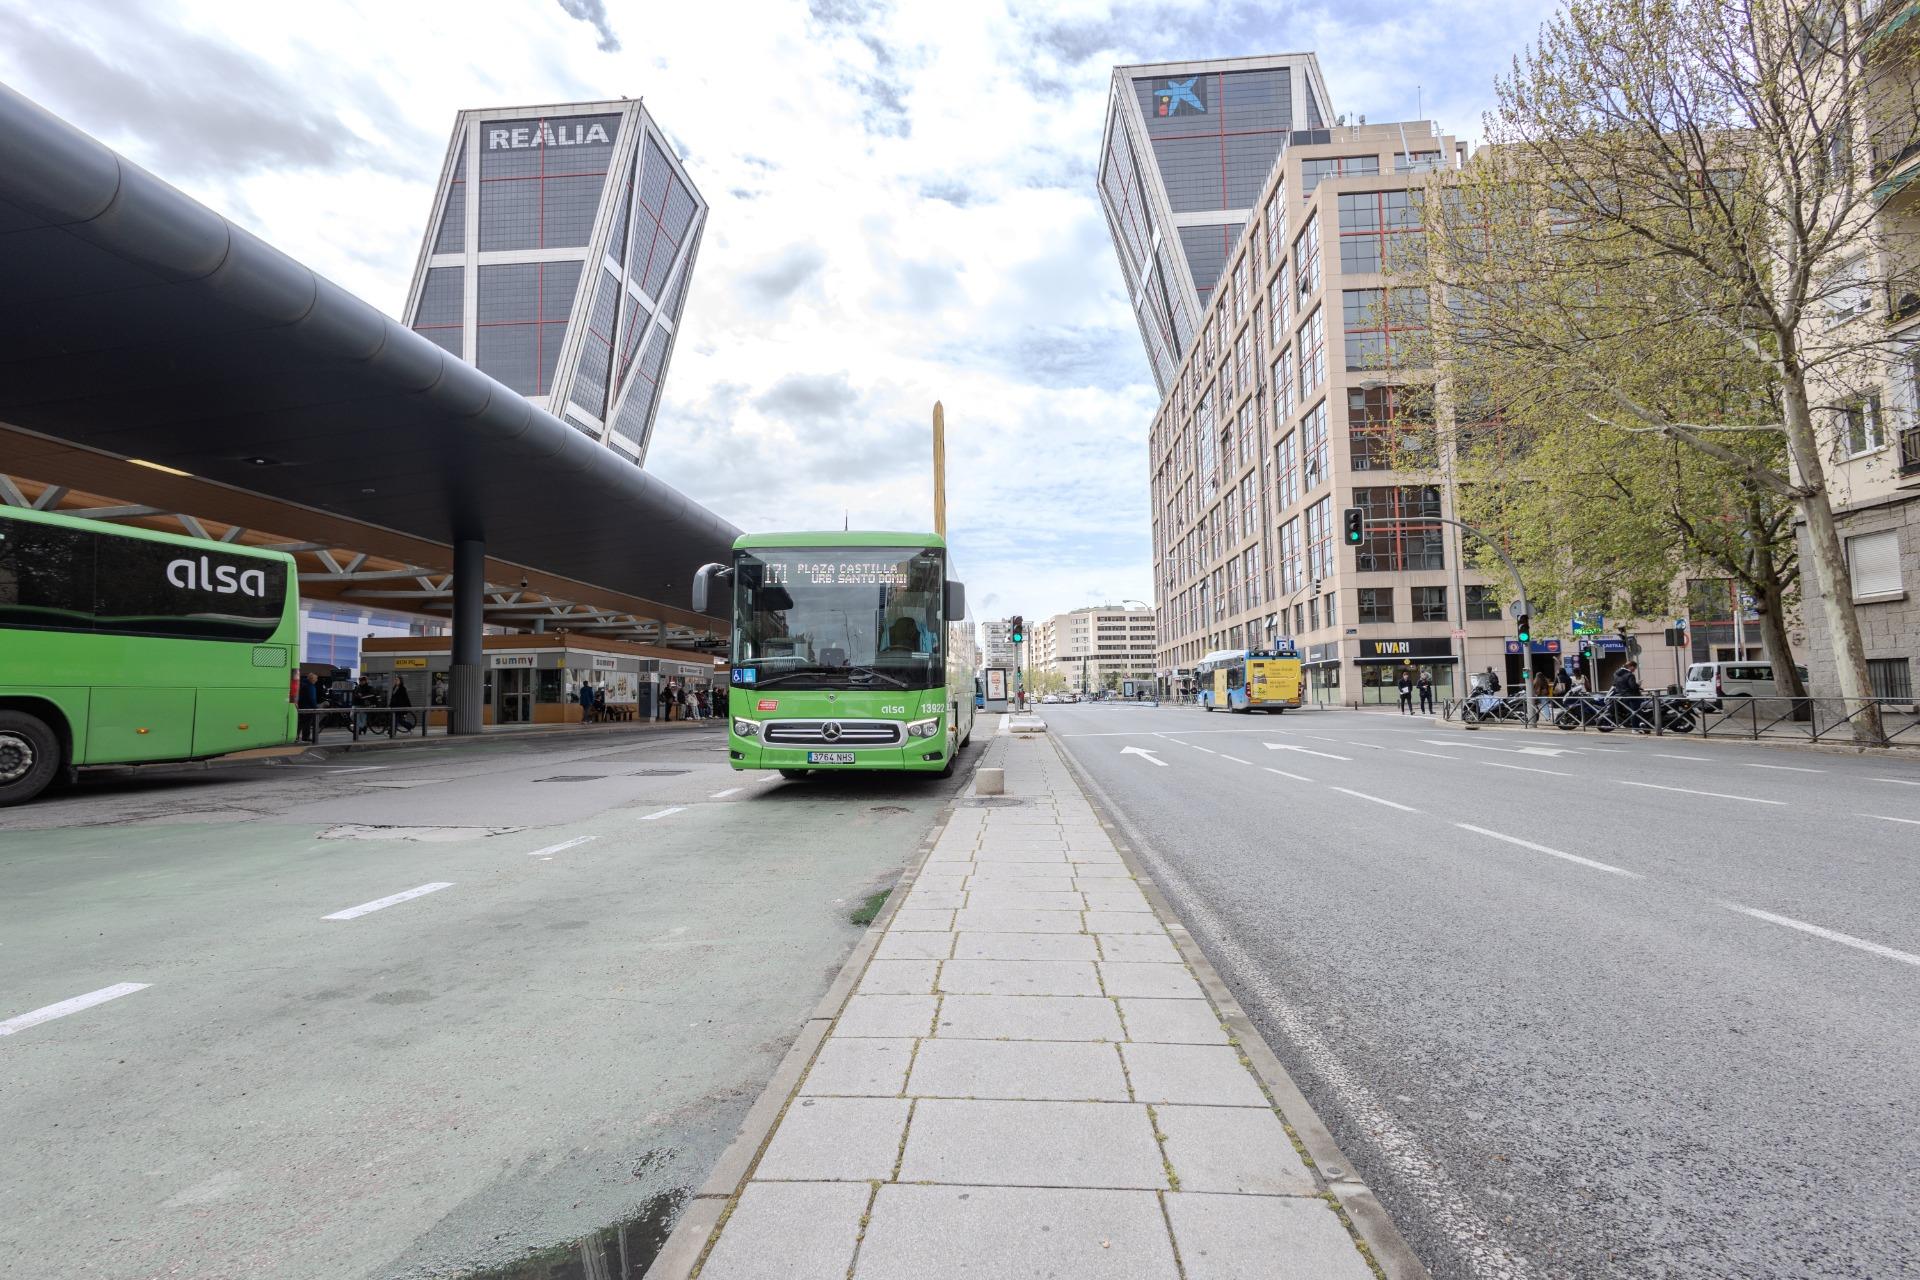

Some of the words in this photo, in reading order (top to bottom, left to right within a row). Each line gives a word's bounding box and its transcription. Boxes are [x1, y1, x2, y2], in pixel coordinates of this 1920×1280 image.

[489, 122, 610, 150] REALIA
[764, 563, 788, 584] 171
[797, 563, 835, 574] PLAZA
[839, 563, 898, 574] CASTILLA
[166, 555, 265, 598] alsa
[811, 573, 835, 584] URB.
[837, 573, 876, 584] SANTO
[1375, 641, 1410, 654] VIVARI
[495, 655, 534, 667] summy
[881, 705, 905, 714] alsa
[920, 703, 945, 714] 13922
[813, 752, 835, 762] 3764
[836, 752, 853, 762] NHS
